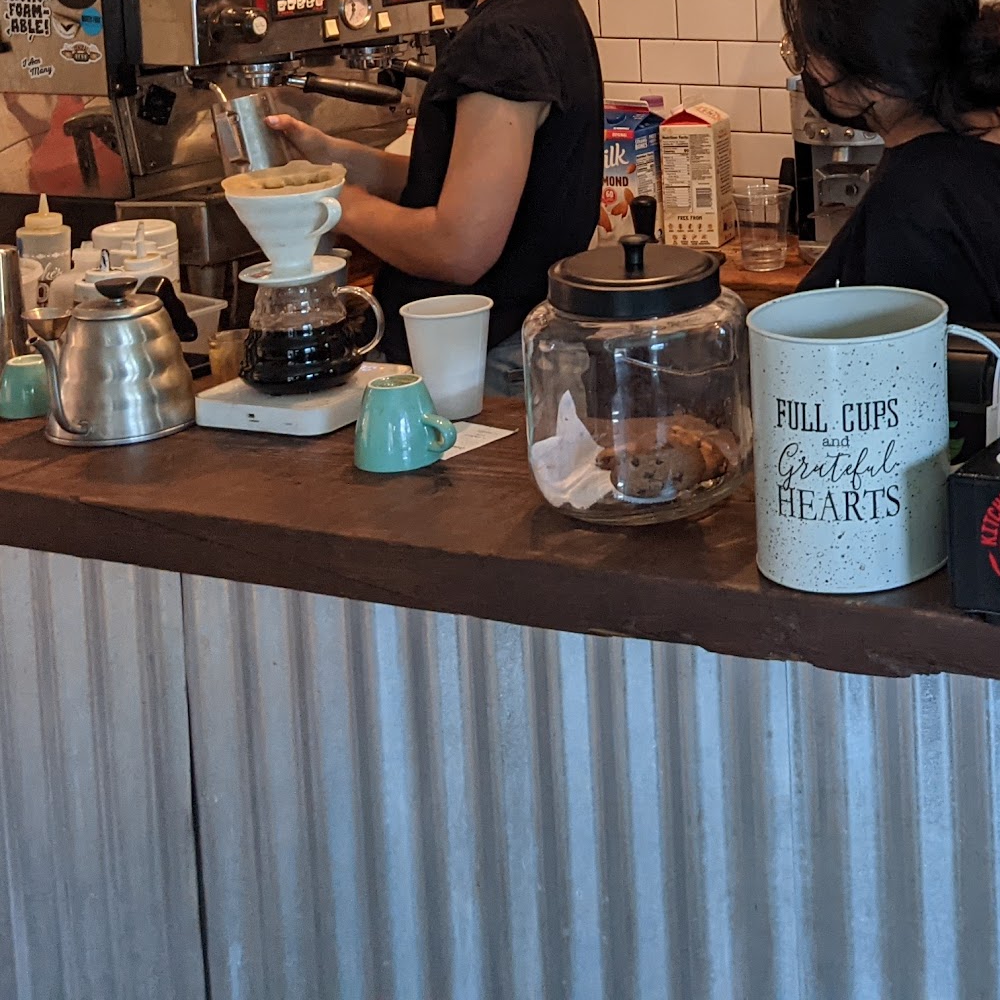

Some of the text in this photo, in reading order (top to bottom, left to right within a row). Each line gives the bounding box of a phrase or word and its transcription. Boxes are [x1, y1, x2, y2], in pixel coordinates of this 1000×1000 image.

[8, 2, 50, 19] FOAM-
[10, 18, 49, 35] ABLE!
[603, 142, 630, 169] ilk
[776, 398, 899, 432] FULL CUPS
[822, 436, 850, 447] and
[778, 439, 900, 491] Grateful
[777, 484, 901, 522] HEARTS
